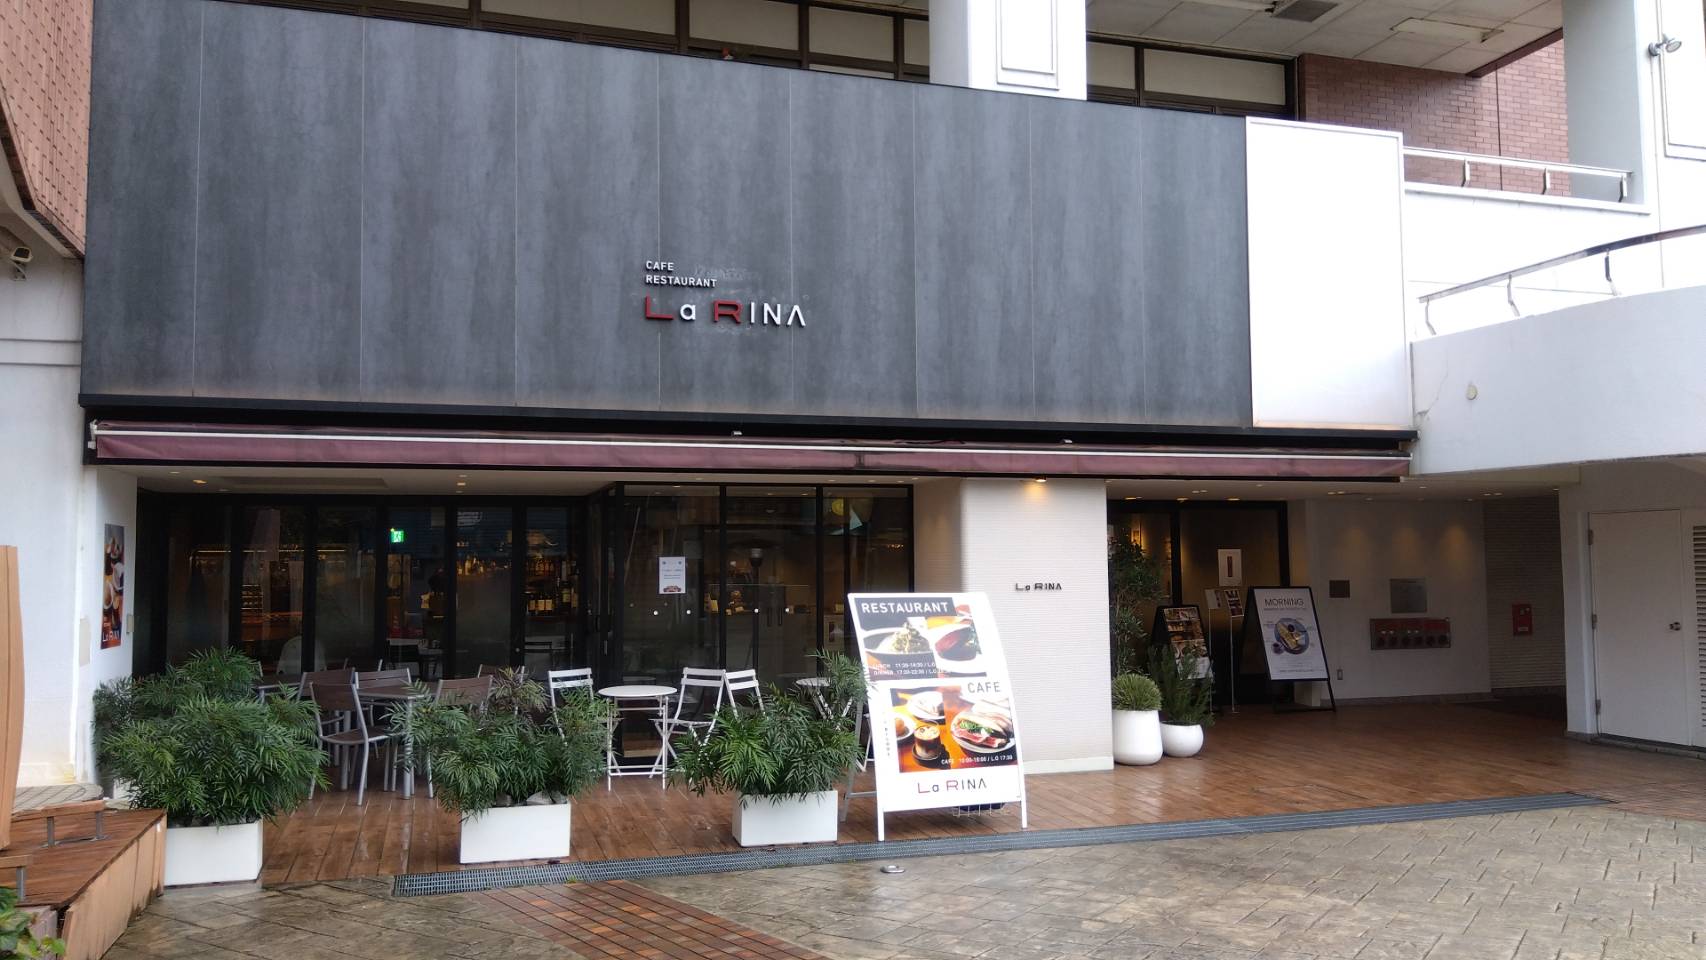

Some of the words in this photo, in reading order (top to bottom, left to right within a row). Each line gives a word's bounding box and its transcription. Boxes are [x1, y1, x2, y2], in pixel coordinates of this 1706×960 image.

[645, 260, 675, 271] CAFE
[645, 275, 717, 288] RESTAURANT
[644, 295, 697, 321] La
[713, 299, 807, 327] RINA
[1034, 582, 1063, 591] RINA
[861, 601, 949, 614] RESTAURANT
[1264, 598, 1305, 607] MORNING
[967, 681, 1001, 694] CAFE
[946, 778, 987, 791] RINA
